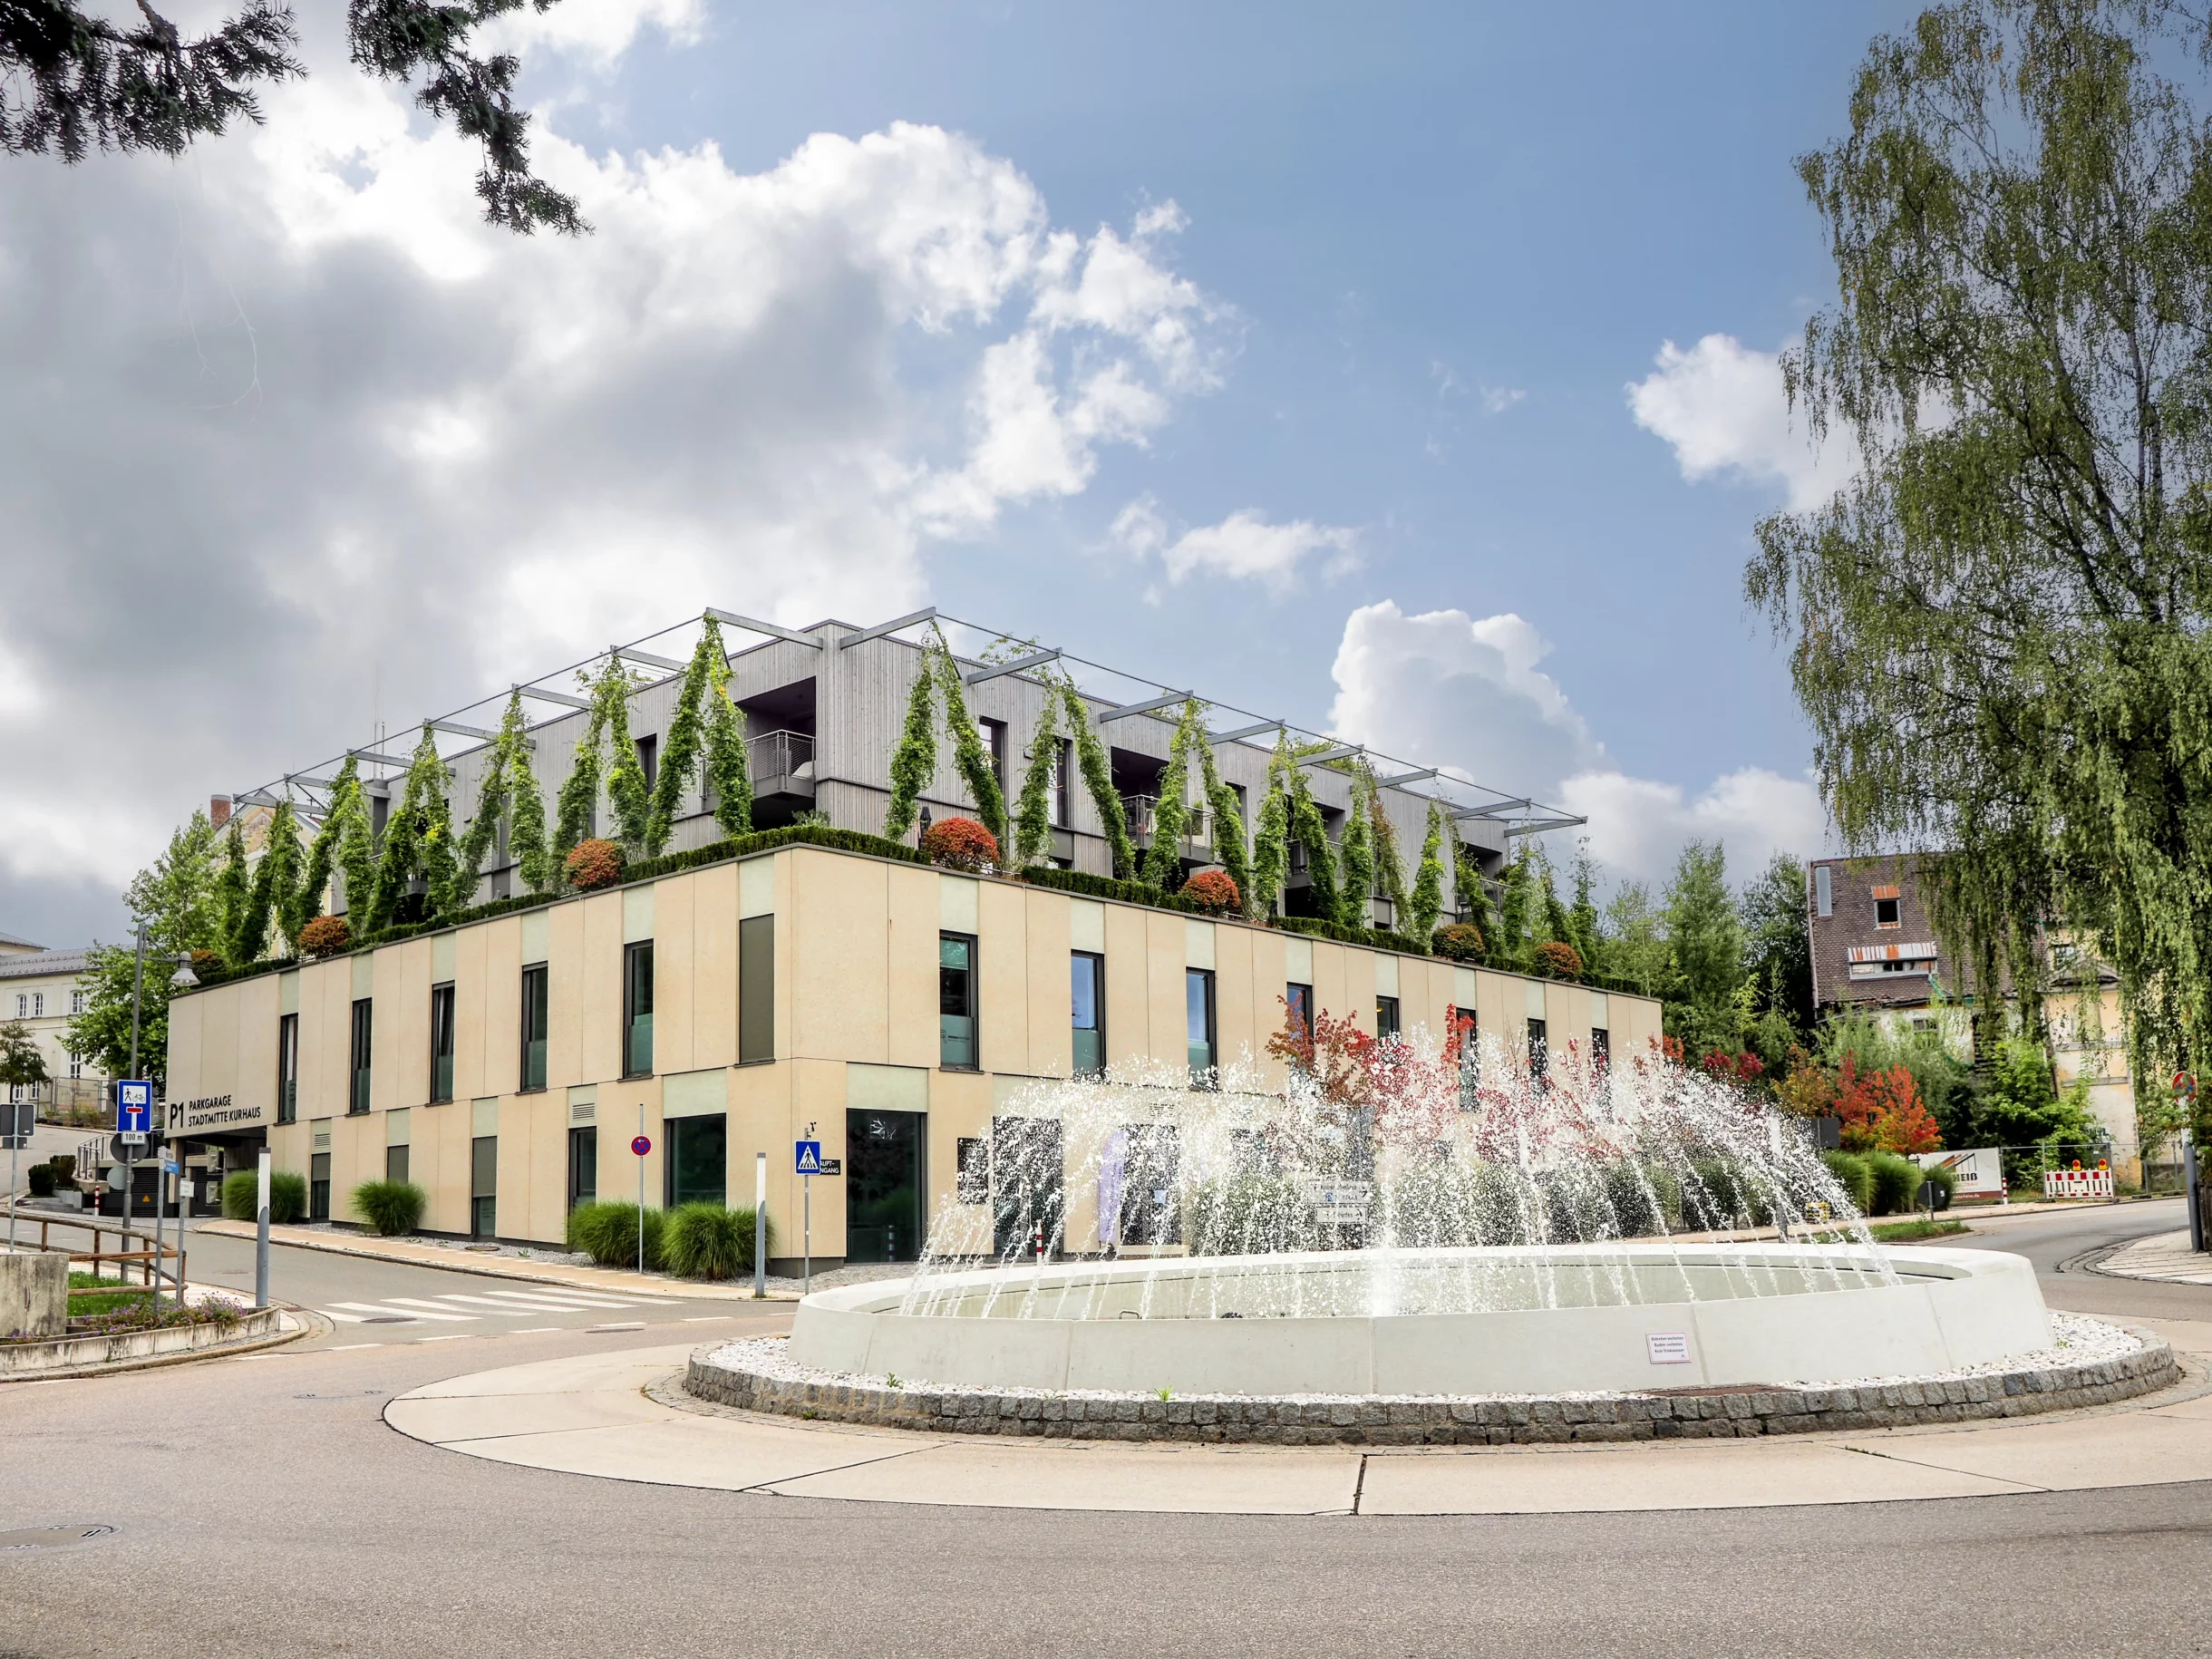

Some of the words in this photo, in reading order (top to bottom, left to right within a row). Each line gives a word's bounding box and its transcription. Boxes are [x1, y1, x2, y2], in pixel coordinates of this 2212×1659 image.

[189, 1095, 231, 1111] PARKGARAGE
[170, 1101, 184, 1130] P1
[189, 1111, 228, 1127] STADTMITTE
[229, 1107, 261, 1121] KURHAUS
[1953, 1172, 1978, 1182] HEIß
